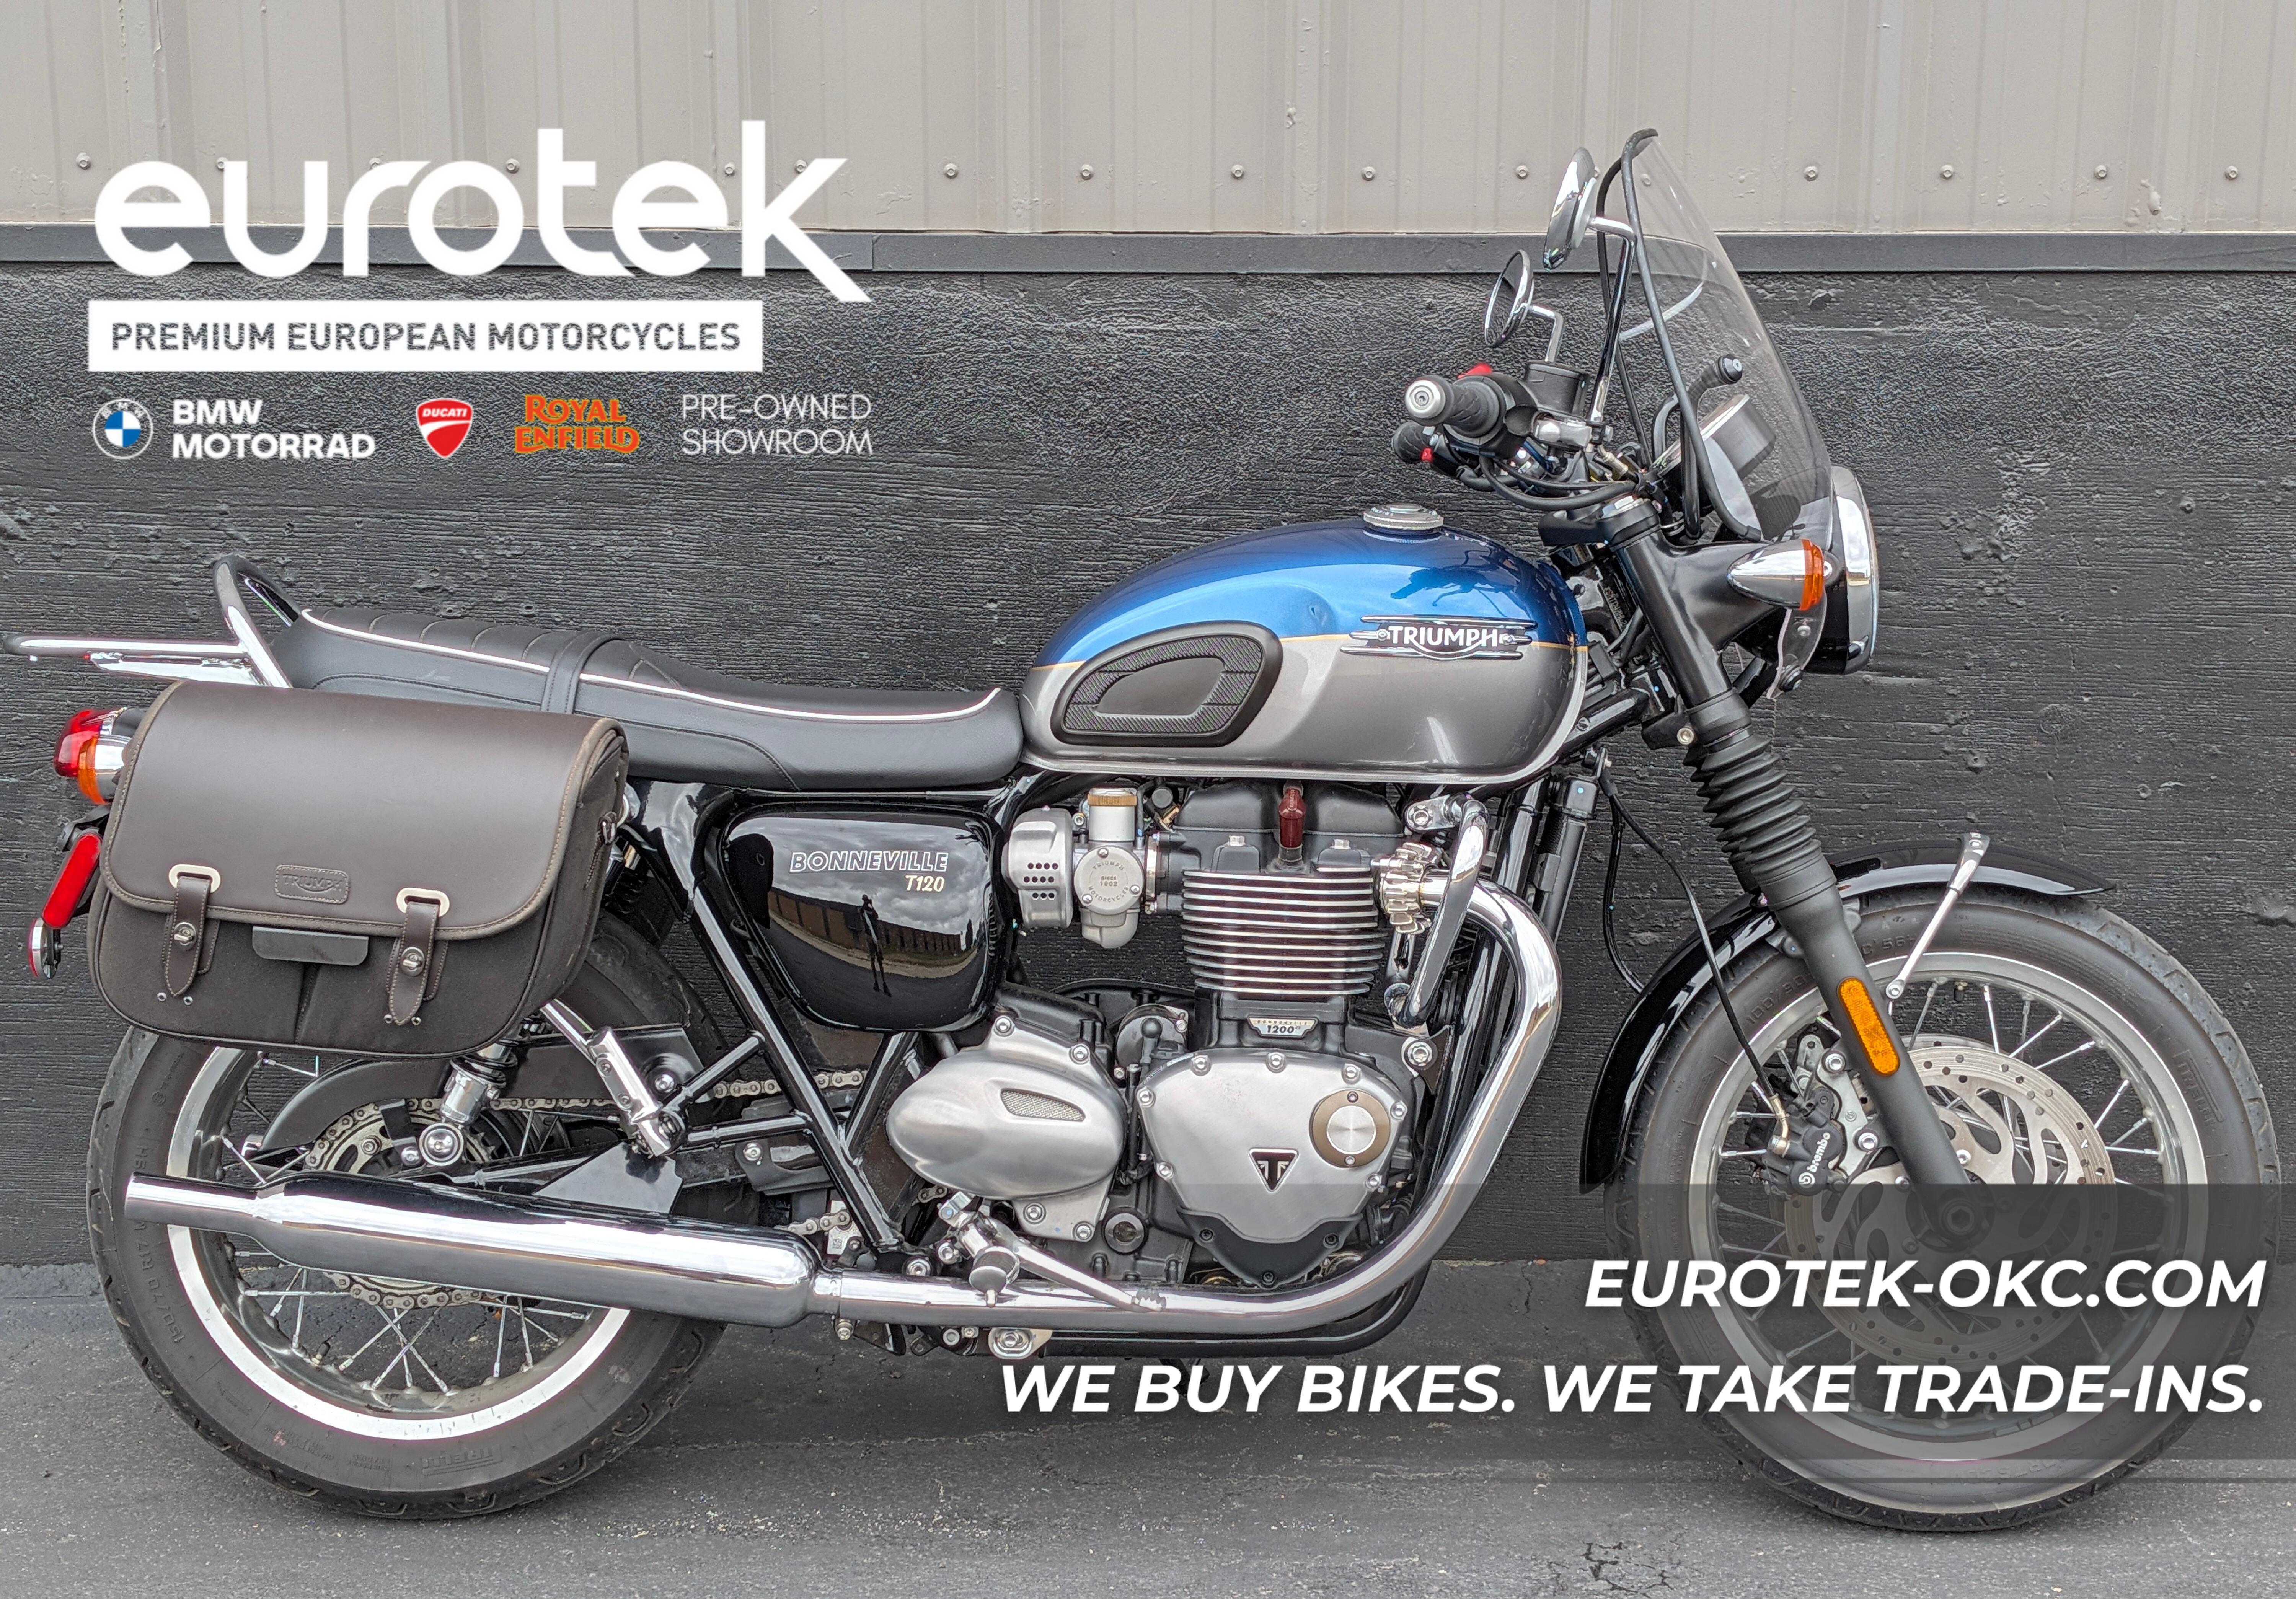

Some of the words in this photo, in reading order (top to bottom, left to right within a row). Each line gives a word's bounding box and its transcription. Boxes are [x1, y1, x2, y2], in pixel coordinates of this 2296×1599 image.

[1388, 626, 1498, 653] TRIUMPH
[789, 850, 949, 874] BONNEVILLE
[282, 874, 342, 893] TRIUMPH
[905, 874, 945, 893] T120
[1807, 1132, 1831, 1173] brembo
